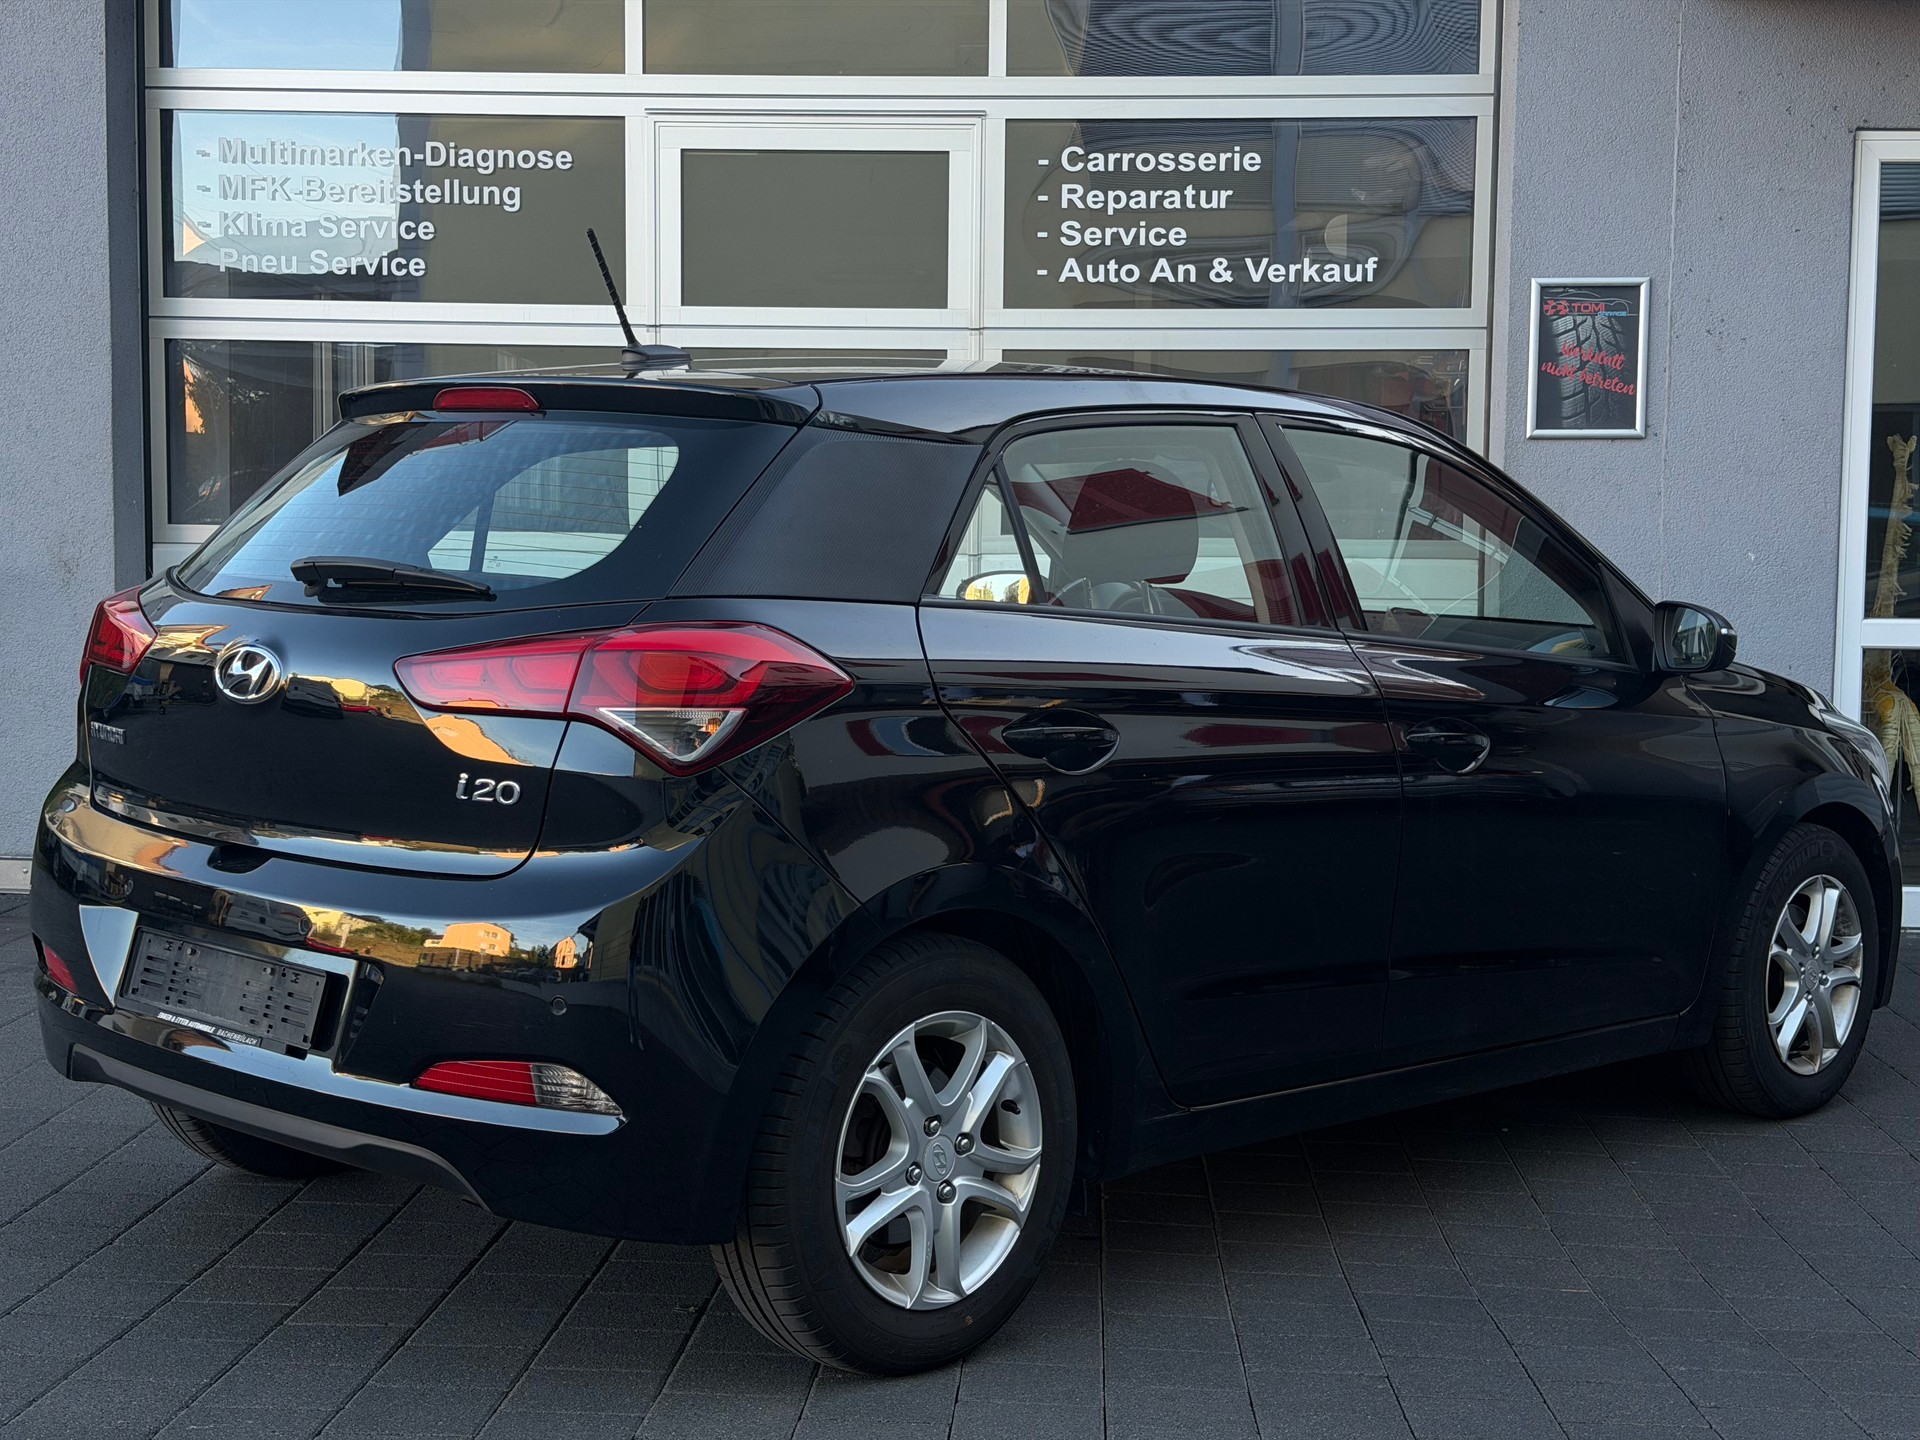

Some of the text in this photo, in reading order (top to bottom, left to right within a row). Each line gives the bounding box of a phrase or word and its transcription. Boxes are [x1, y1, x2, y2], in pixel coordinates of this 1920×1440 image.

[218, 138, 574, 175] Multimarken-Diagnose
[1061, 146, 1262, 172] Carrosserie
[218, 176, 522, 212] MFK-Bereitstellung
[1060, 184, 1233, 216] Reparatur
[218, 211, 307, 238] Klima
[318, 213, 436, 241] Service
[1059, 221, 1188, 247] Service
[219, 248, 299, 274] Pneu
[309, 250, 427, 277] Service
[1058, 258, 1141, 284] Auto
[1149, 257, 1197, 283] An
[1209, 257, 1234, 284] &
[1244, 257, 1379, 284] Verkauf
[1579, 368, 1636, 396] betreten
[455, 772, 521, 806] i20
